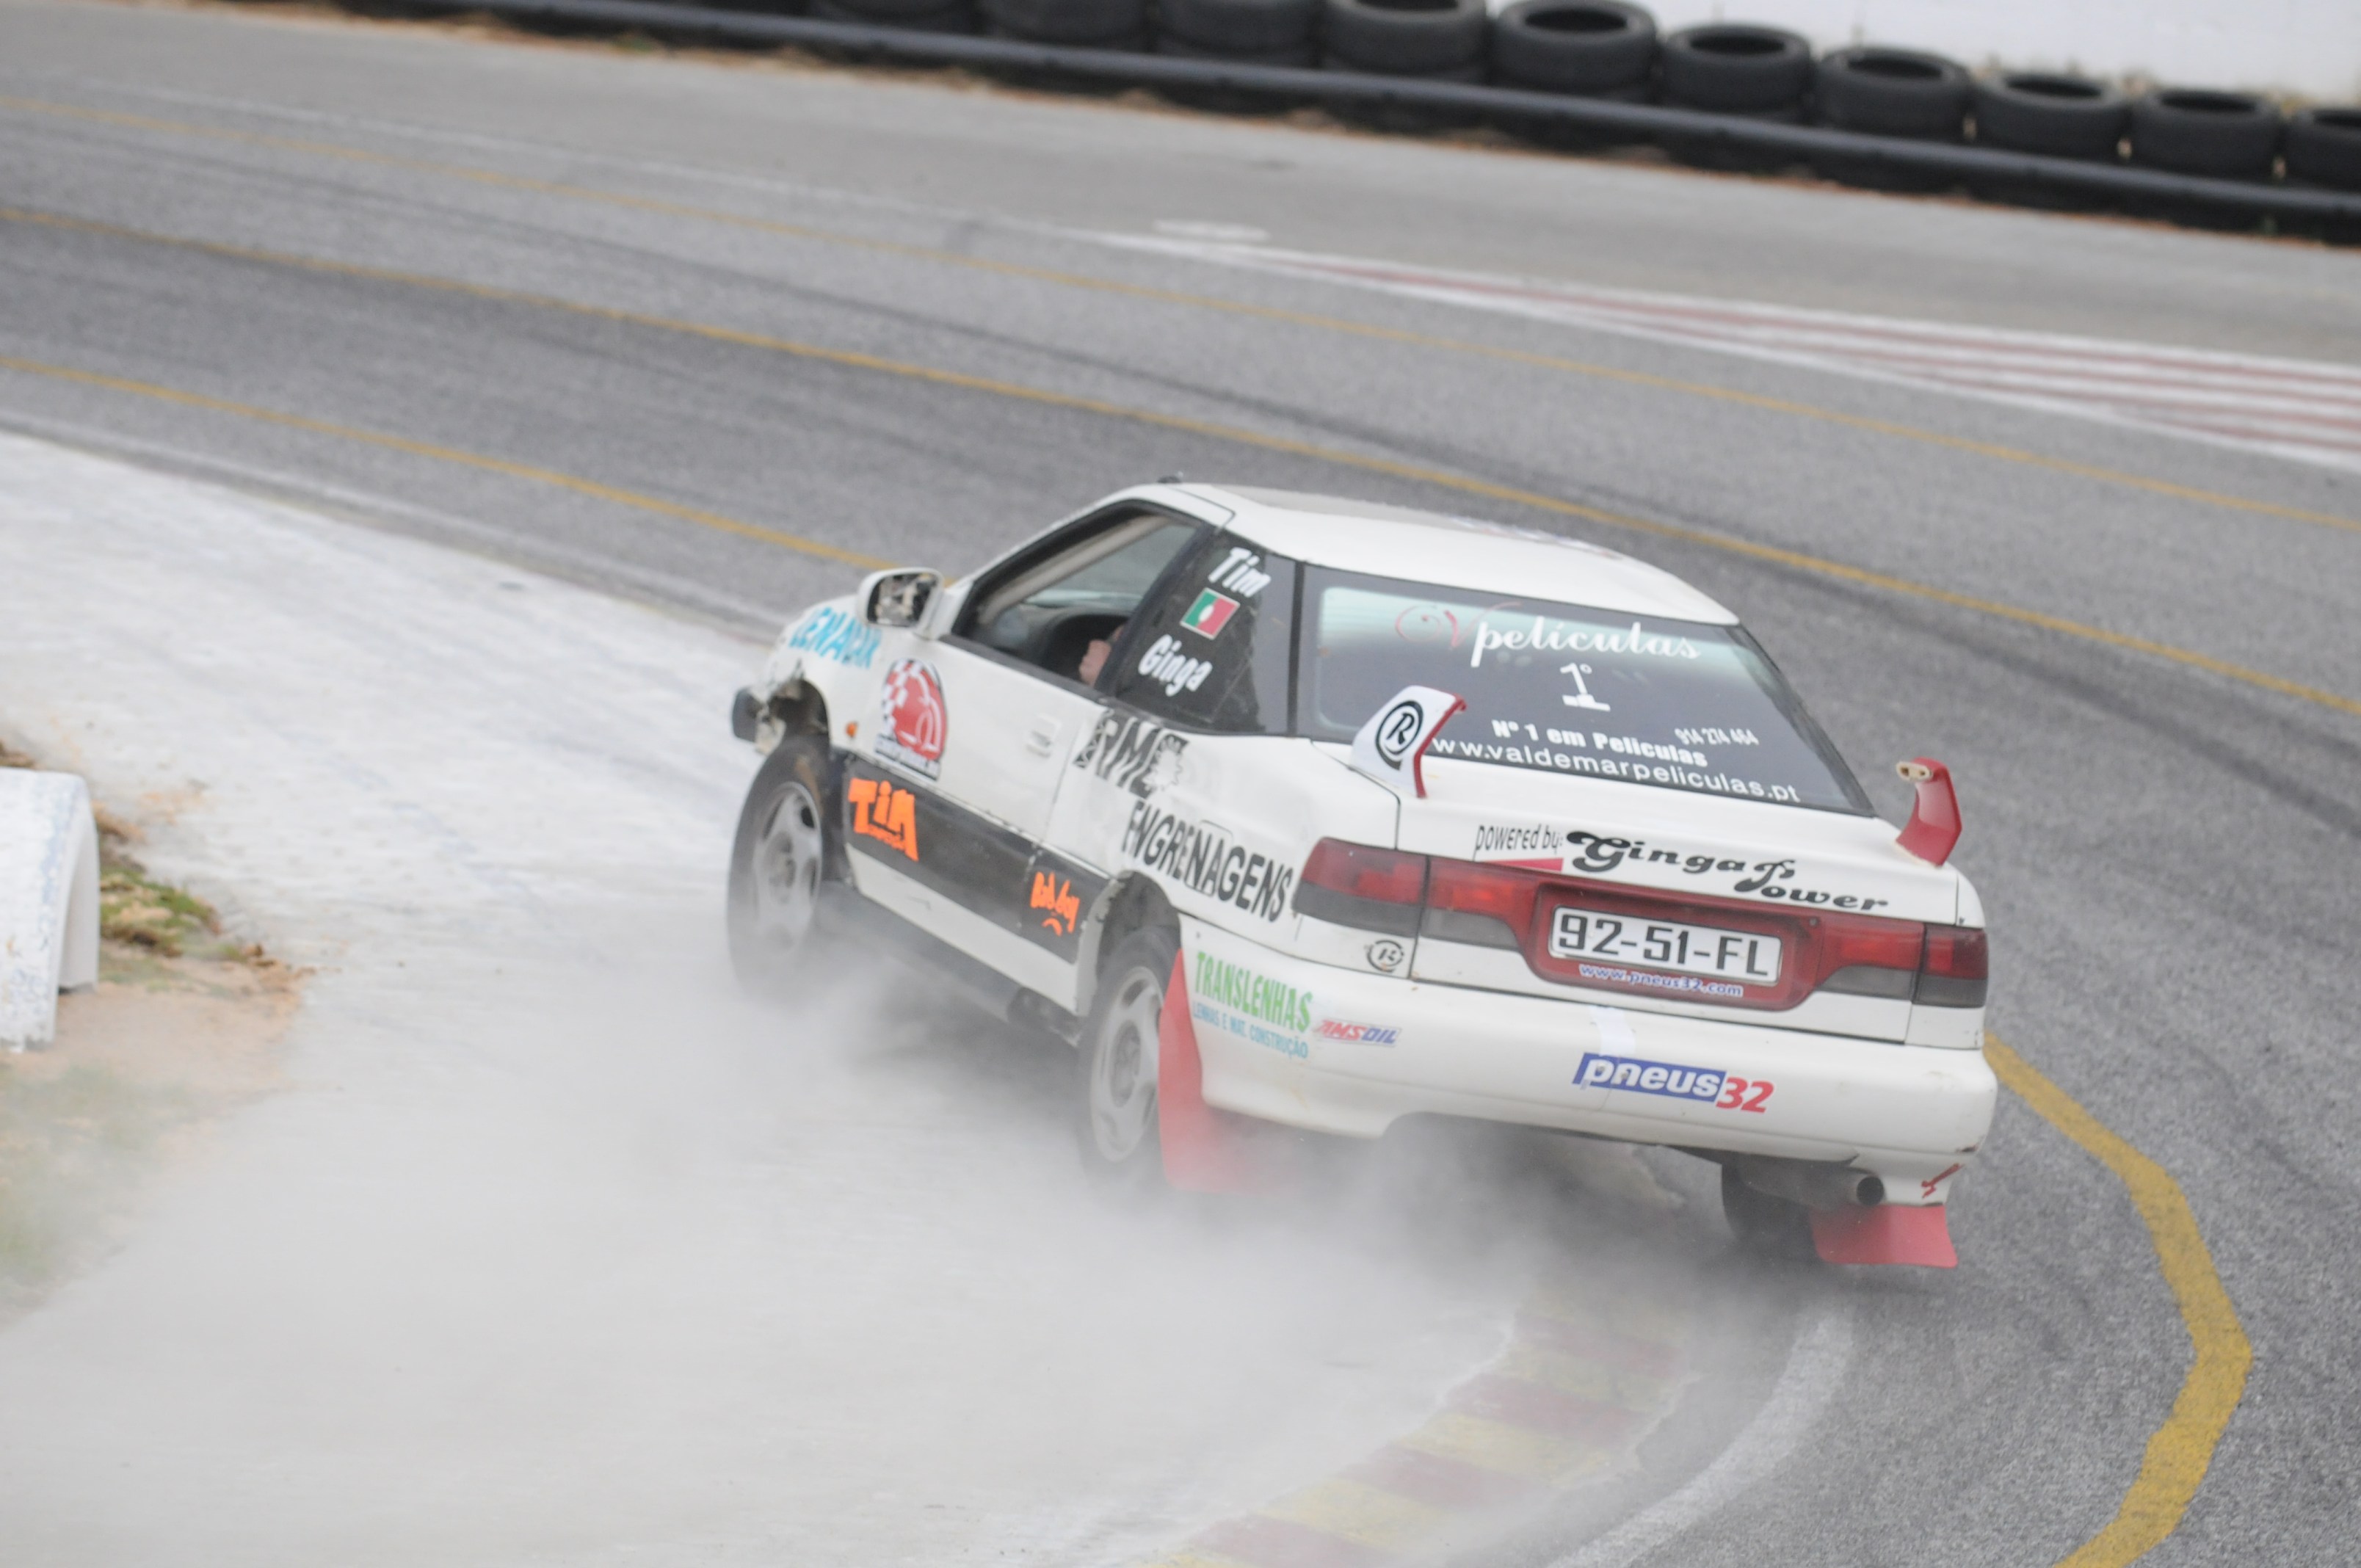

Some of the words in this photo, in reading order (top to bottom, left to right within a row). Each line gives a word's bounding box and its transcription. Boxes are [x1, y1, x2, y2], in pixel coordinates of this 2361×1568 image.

[1208, 547, 1272, 598] Tim
[1138, 634, 1213, 697] Ginga
[1524, 723, 1539, 741] 1
[1546, 727, 1586, 747] em
[1433, 738, 1800, 802] ww.valdemarpeliculas.pt
[1122, 799, 1293, 922] ENGRENAGENS
[1472, 824, 1542, 862] powered
[1566, 831, 1746, 874] Ginga
[1733, 860, 1888, 910] Power
[1559, 914, 1769, 977] 92-51-FL
[1194, 951, 1313, 1033] TRANSLENHAS
[1579, 964, 1744, 998] www.pneus32.com
